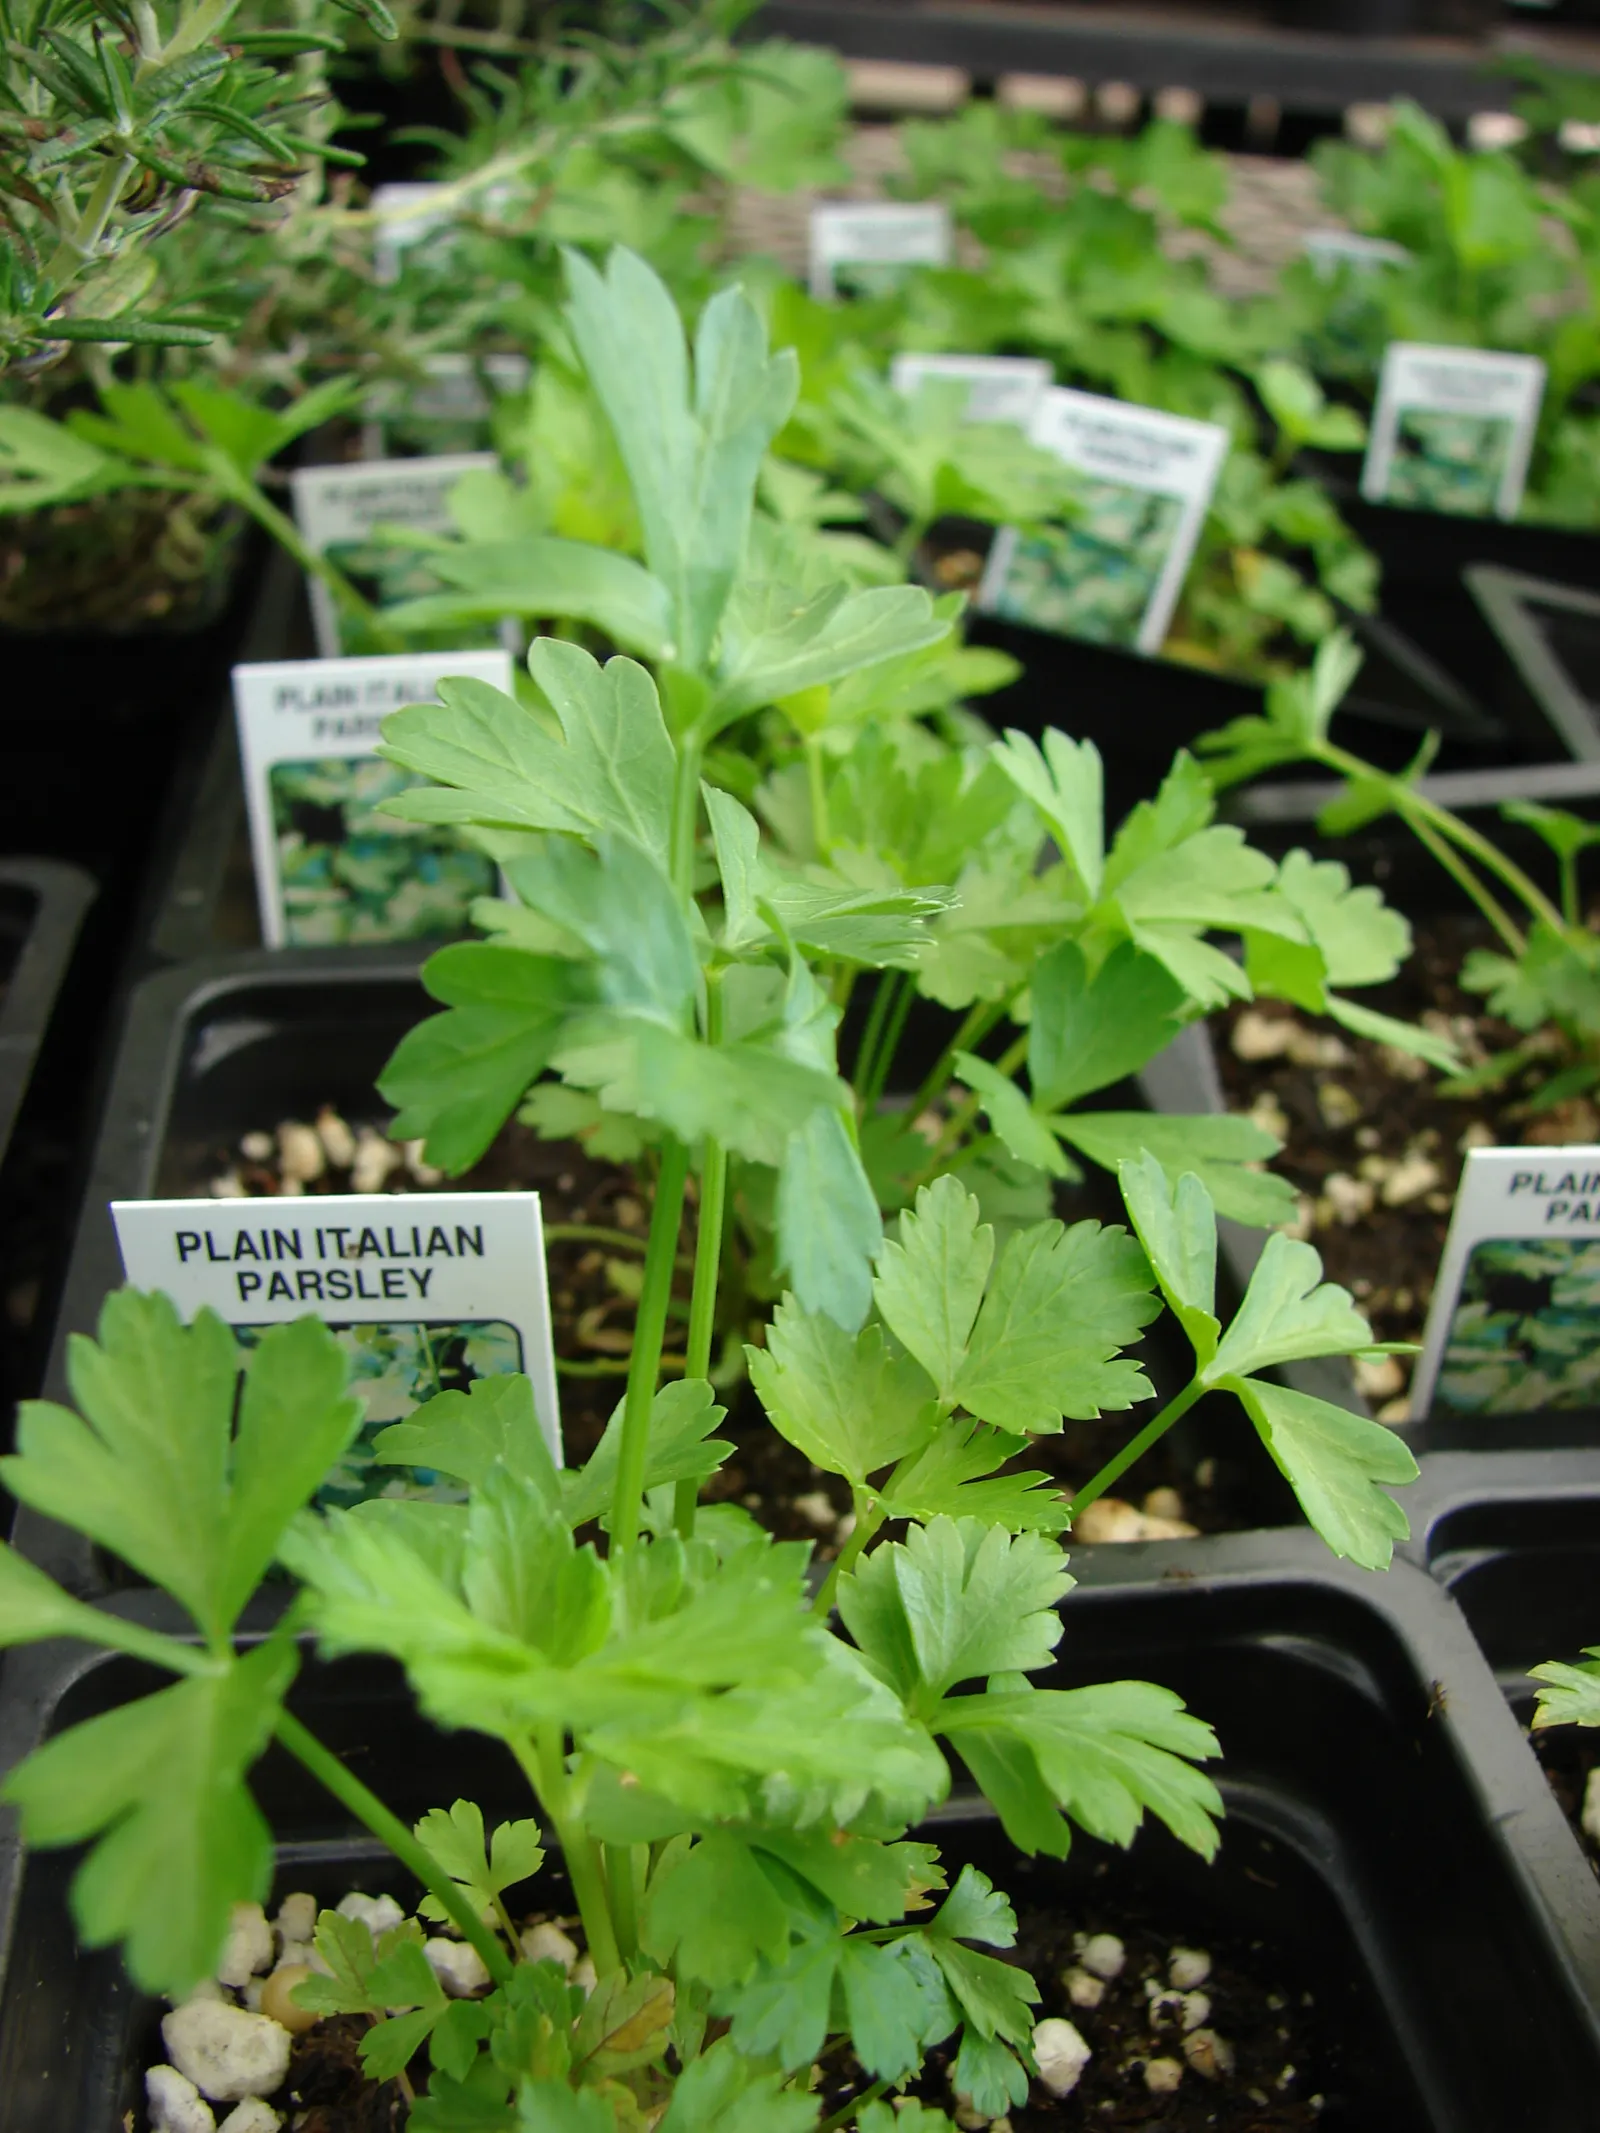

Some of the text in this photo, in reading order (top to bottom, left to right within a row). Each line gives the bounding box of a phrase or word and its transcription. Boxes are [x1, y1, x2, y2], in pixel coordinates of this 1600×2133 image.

[176, 1225, 485, 1262] PLAIN ITALIAN
[236, 1267, 434, 1301] PARSLEY
